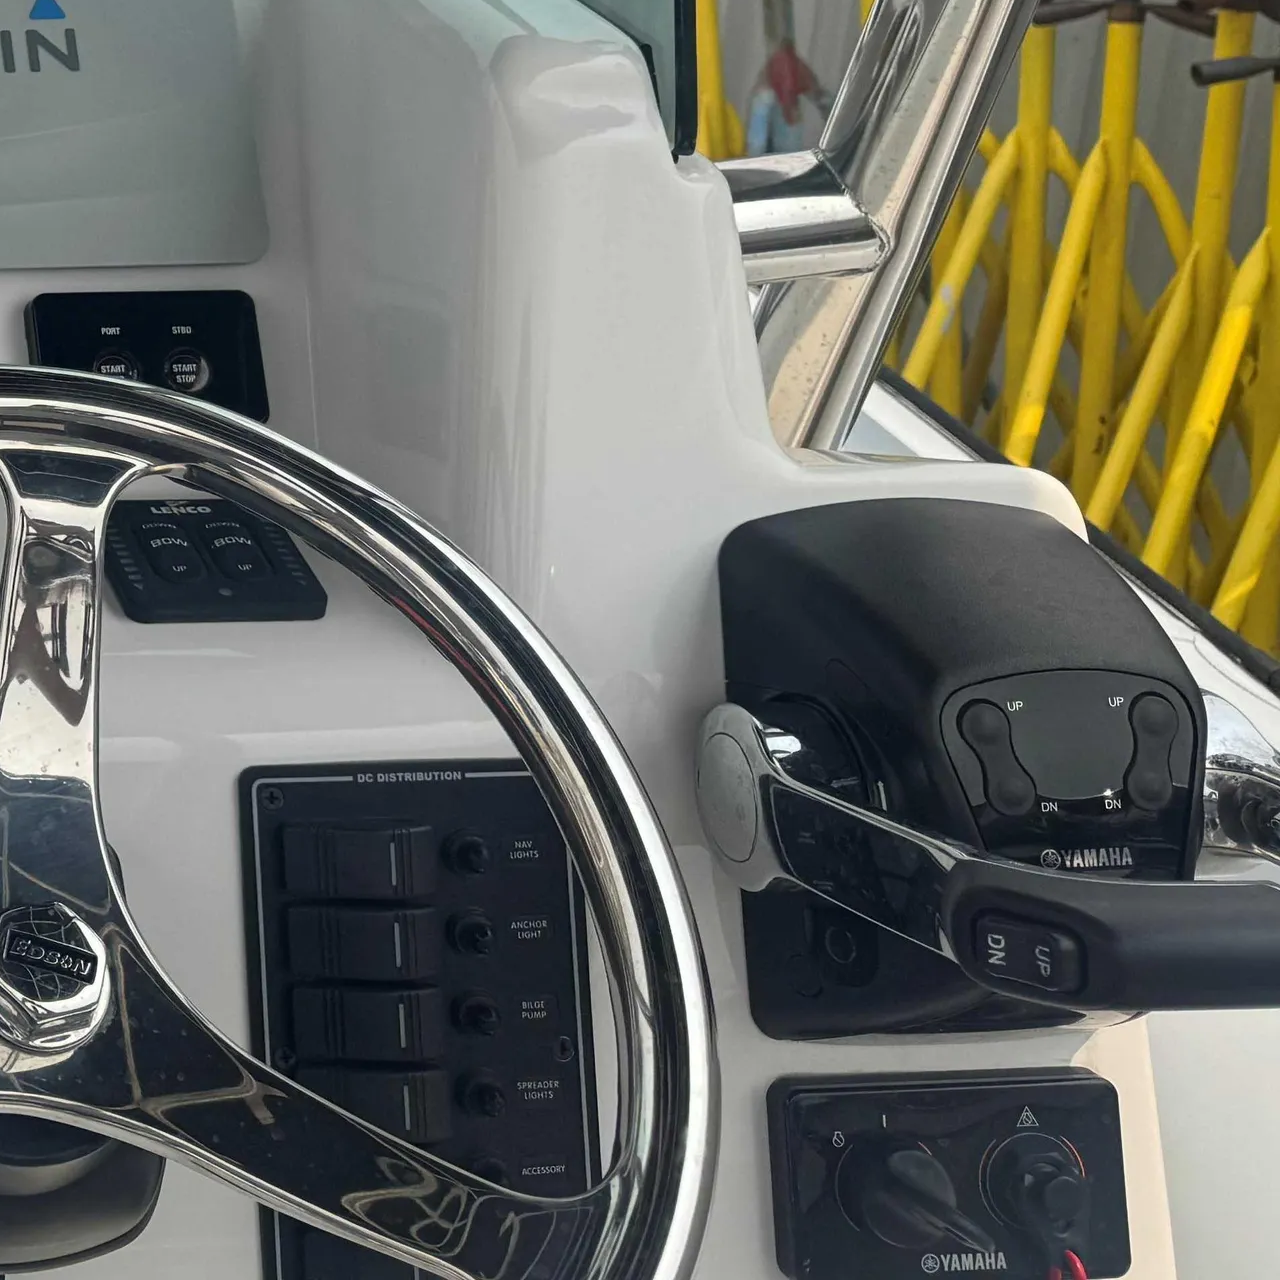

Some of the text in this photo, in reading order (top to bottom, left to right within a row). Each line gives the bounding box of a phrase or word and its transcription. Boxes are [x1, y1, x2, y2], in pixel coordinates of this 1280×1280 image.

[100, 326, 121, 336] PORT
[171, 325, 192, 335] STBD
[100, 364, 126, 374] START
[172, 363, 197, 373] START
[176, 374, 196, 384] STOP
[150, 505, 212, 515] LENCO
[150, 537, 189, 549] BOW
[213, 536, 252, 548] BOW
[172, 564, 187, 573] UP
[237, 563, 253, 572] UP
[1006, 701, 1024, 712] UP
[1107, 696, 1125, 708] UP
[357, 770, 462, 783] DC DISTRIBUTION
[1040, 801, 1059, 813] DN
[1104, 798, 1122, 810] DN
[514, 841, 533, 851] NAV
[510, 849, 539, 860] LIGHTS
[1060, 847, 1133, 868] YAMAHA
[510, 920, 548, 930] ANCHOR
[517, 929, 542, 939] LIGHT
[987, 933, 1007, 966] DN
[9, 937, 92, 976] EDSON
[1034, 945, 1051, 978] UP
[521, 1001, 545, 1010] BILGE
[521, 1009, 547, 1020] PUMP
[516, 1080, 560, 1091] SPREADER
[524, 1090, 554, 1100] LIGHTS
[521, 1165, 566, 1176] ACCESSORY
[940, 1251, 1007, 1272] YAMAHA
